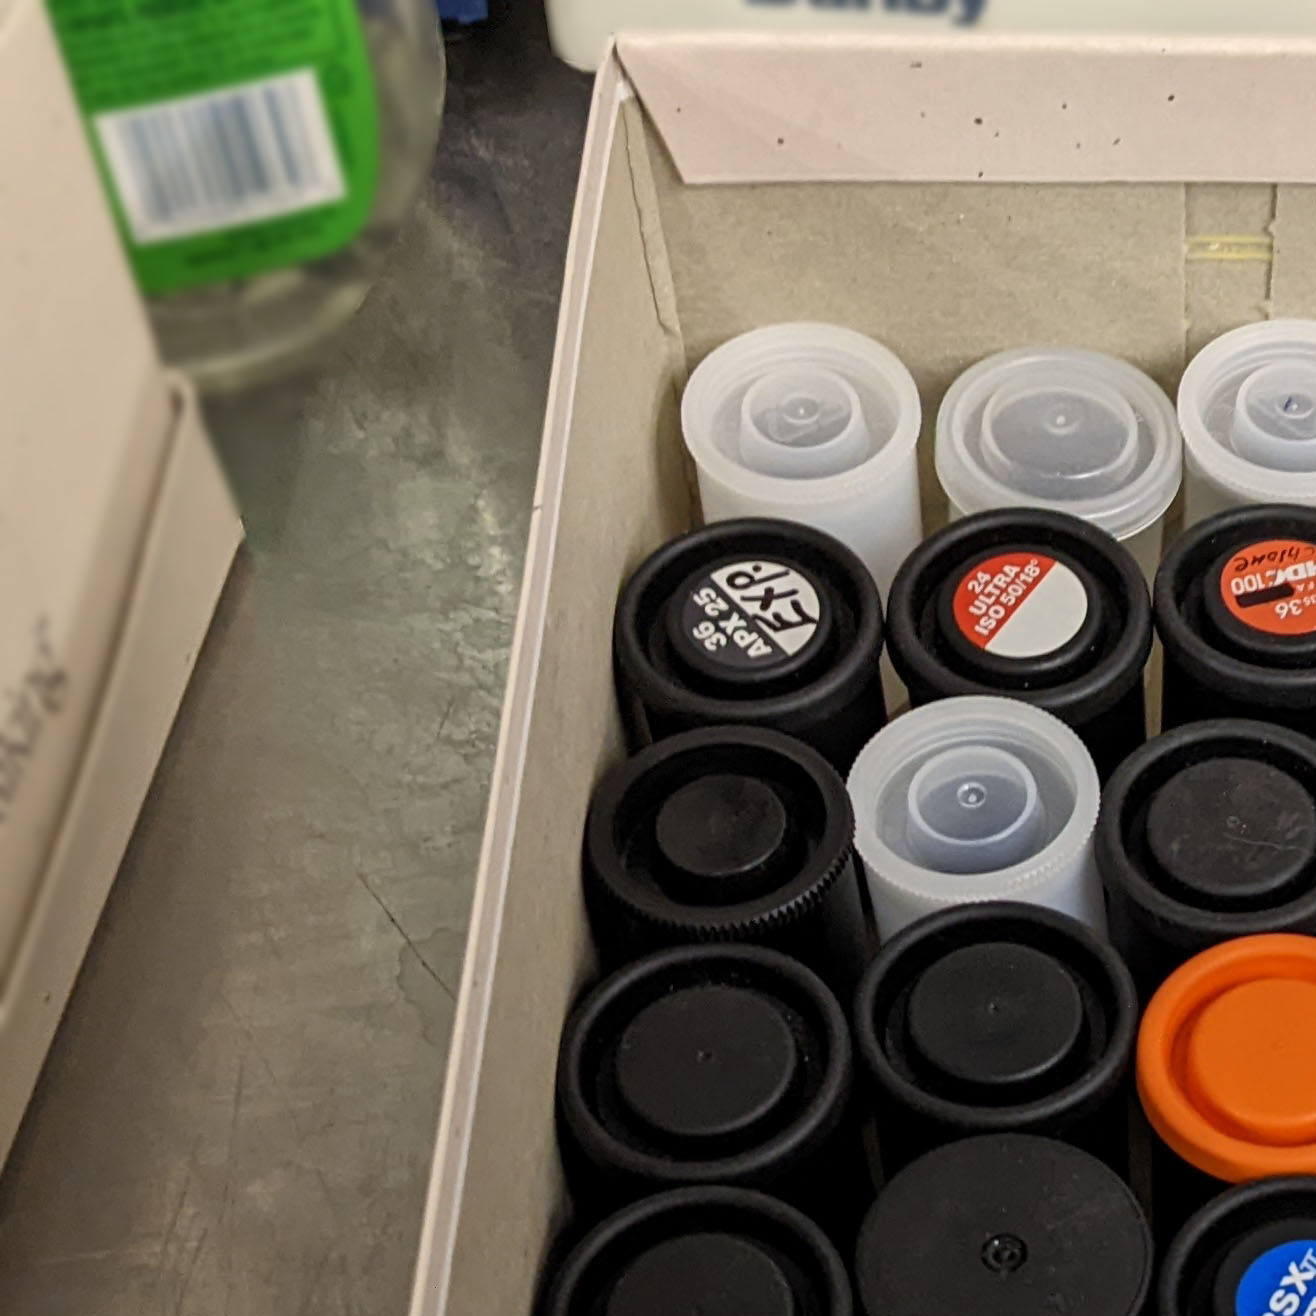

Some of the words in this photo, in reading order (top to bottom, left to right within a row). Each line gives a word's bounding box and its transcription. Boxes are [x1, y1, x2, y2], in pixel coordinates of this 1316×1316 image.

[967, 571, 992, 594] 24
[968, 564, 1021, 616] ULTRA
[1230, 572, 1266, 596] 100
[692, 587, 730, 617] 25
[1275, 599, 1303, 619] 36
[974, 604, 1006, 636] ISO
[692, 621, 727, 651] 36
[718, 612, 773, 659] APX
